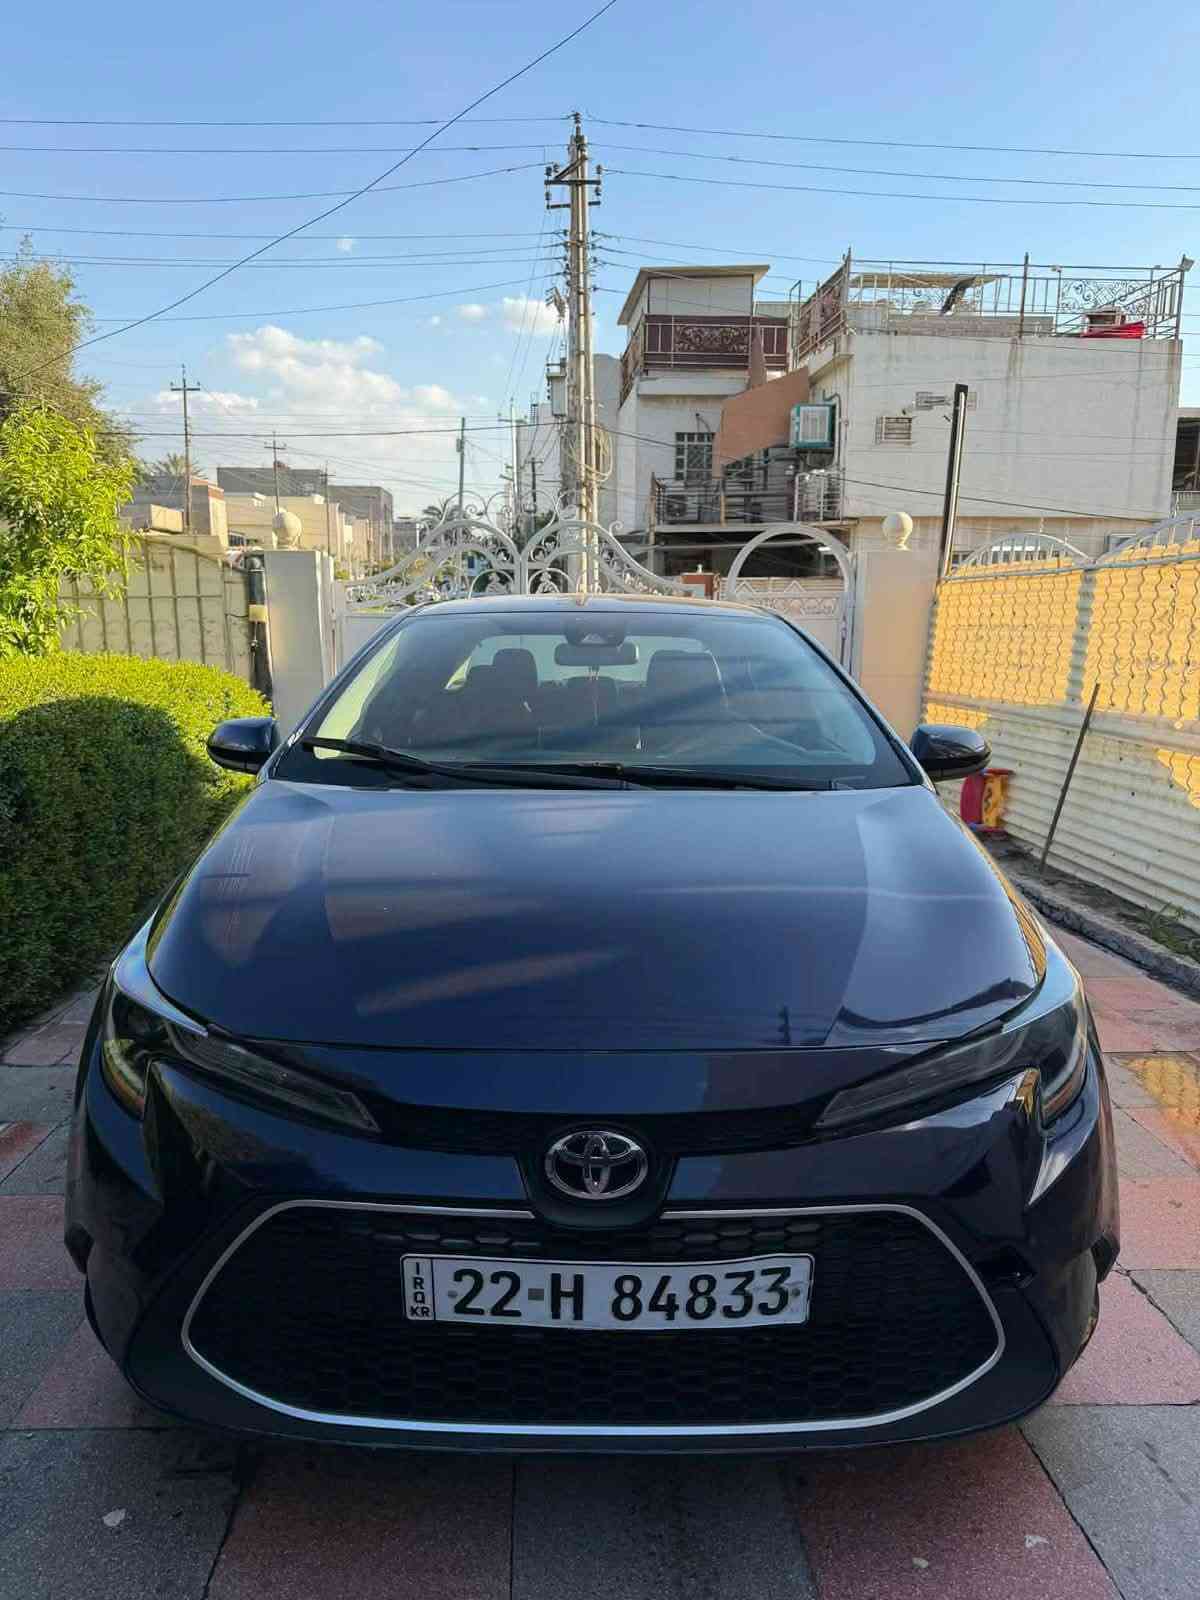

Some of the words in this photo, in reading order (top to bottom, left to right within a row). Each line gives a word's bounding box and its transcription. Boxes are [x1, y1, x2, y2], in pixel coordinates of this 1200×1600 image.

[453, 1268, 522, 1317] 22
[550, 1272, 584, 1320] H
[611, 1266, 791, 1321] 84833
[410, 1306, 430, 1317] KR
